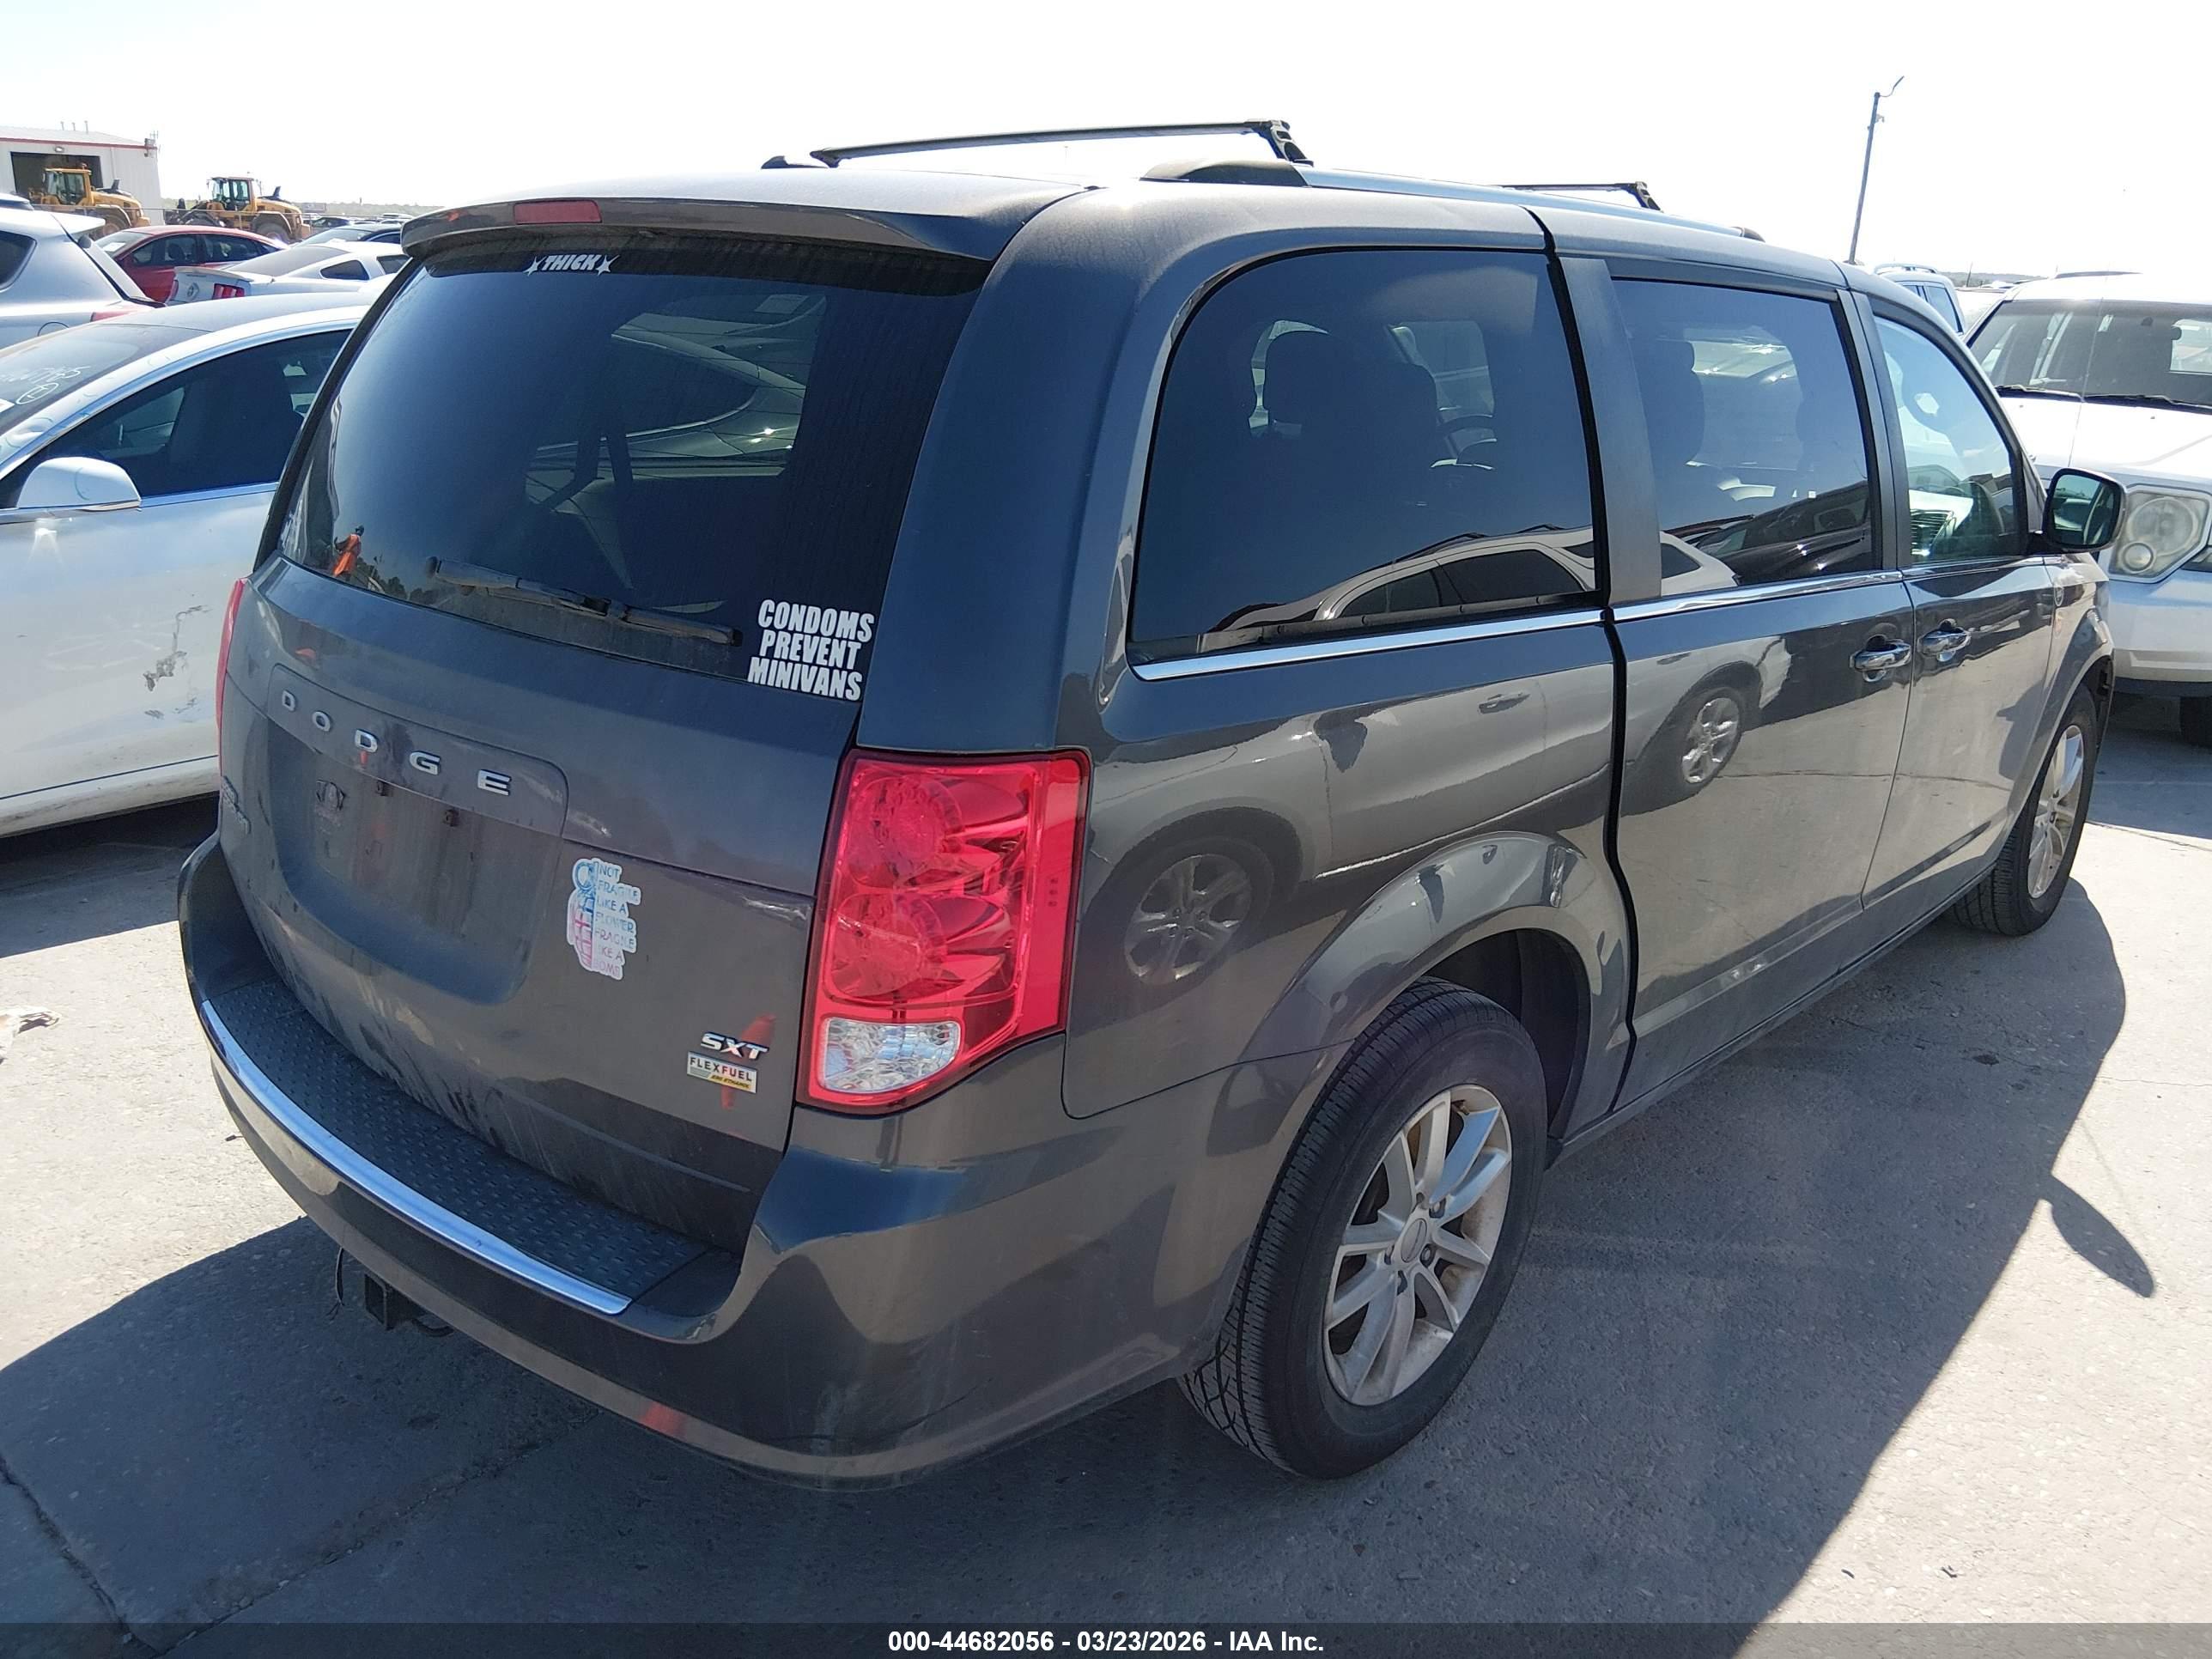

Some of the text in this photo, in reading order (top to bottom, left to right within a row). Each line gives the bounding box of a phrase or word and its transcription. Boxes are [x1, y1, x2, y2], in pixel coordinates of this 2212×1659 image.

[757, 599, 875, 643] CONDOMS
[759, 629, 861, 670] PREVENT
[747, 657, 863, 702] MINIVANS
[282, 690, 513, 796] DODGE
[599, 864, 619, 878] NOT
[619, 903, 627, 914] A
[594, 943, 623, 962] IKE A
[701, 1033, 769, 1059] SXT
[690, 1057, 752, 1082] FLEXFUEL
